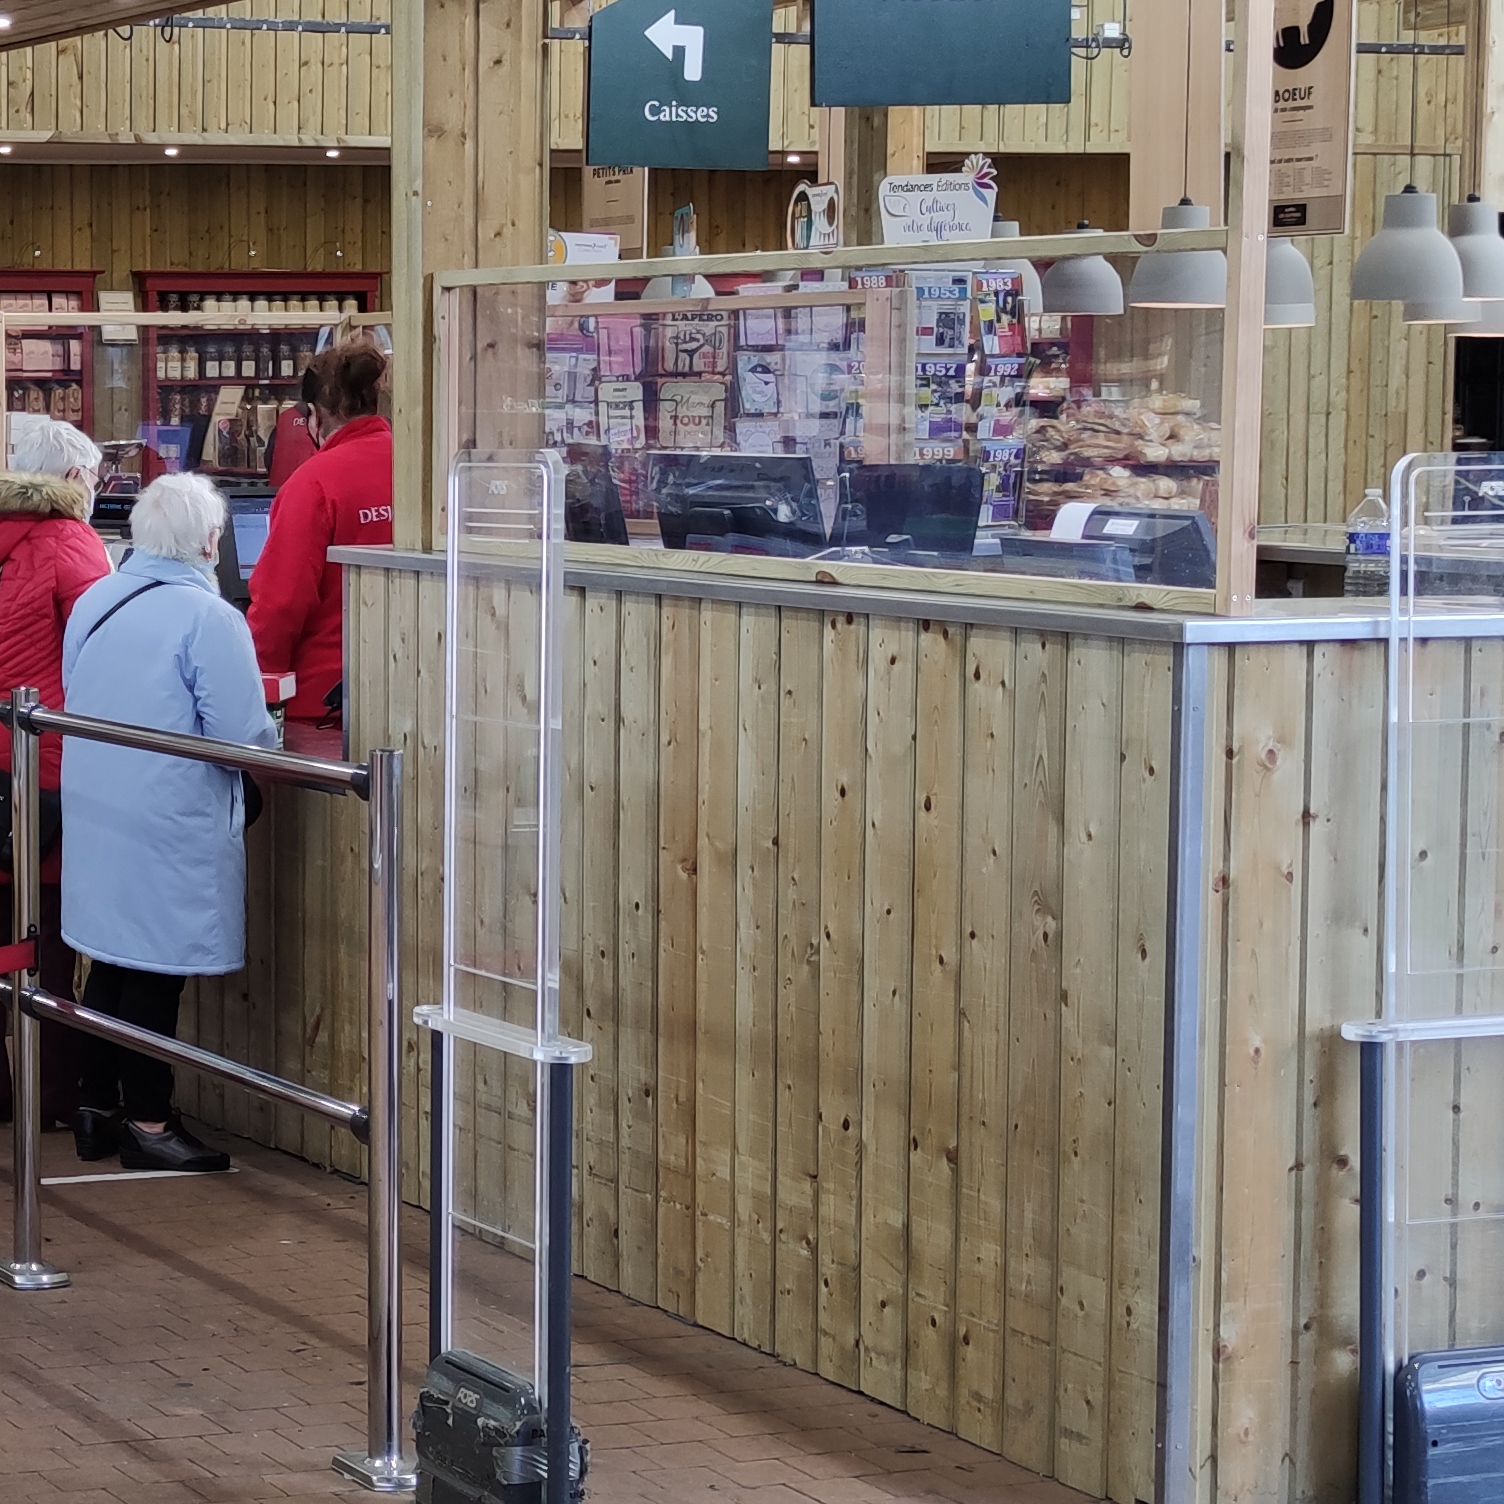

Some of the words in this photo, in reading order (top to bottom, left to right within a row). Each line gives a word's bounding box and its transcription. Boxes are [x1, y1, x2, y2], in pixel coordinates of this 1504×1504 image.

[1273, 85, 1315, 104] BOEUF
[643, 100, 719, 124] Caisses
[888, 181, 934, 194] Tendances
[936, 177, 971, 192] Éditions
[856, 275, 887, 289] 1988
[981, 277, 1012, 292] 1983
[922, 286, 960, 299] 1953
[915, 362, 958, 376] 1957
[989, 362, 1019, 377] 1992
[669, 415, 714, 427] TOUT
[913, 447, 955, 460] 1999
[989, 448, 1018, 462] 1987
[456, 1387, 481, 1408] FORS
